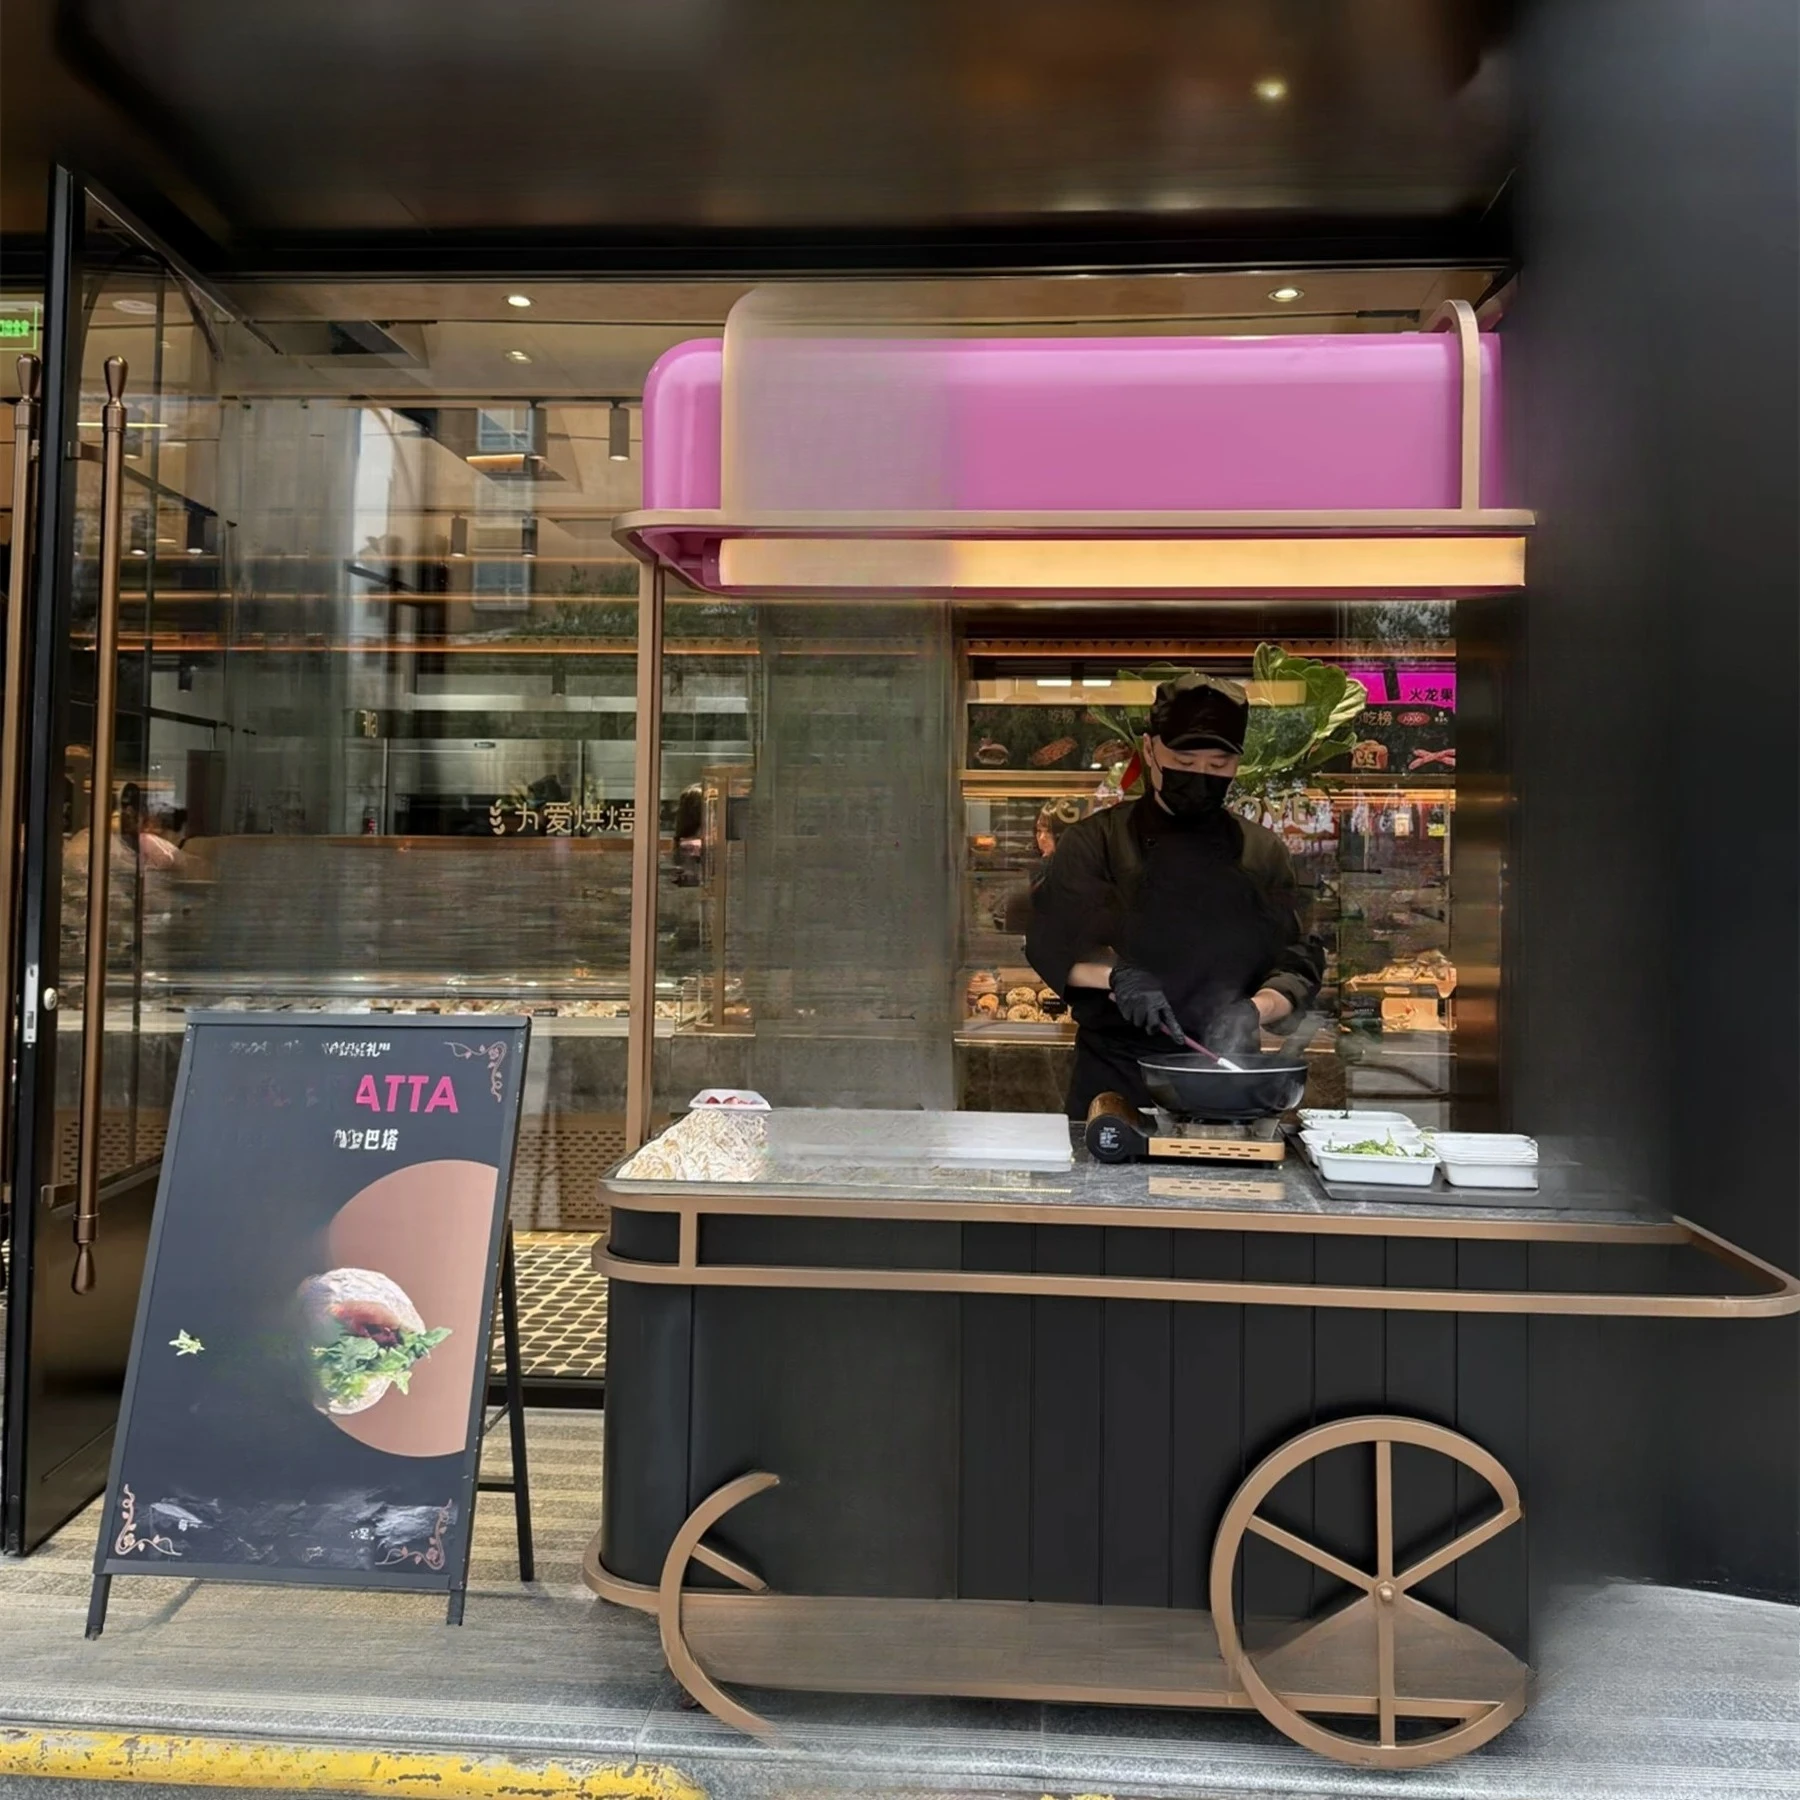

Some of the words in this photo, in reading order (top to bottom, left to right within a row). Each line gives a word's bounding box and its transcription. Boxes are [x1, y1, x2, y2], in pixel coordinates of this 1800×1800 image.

[1409, 687, 1453, 702] 火龙果
[1361, 710, 1393, 726] 吃榜
[514, 801, 635, 834] 为爱烘焙
[1232, 794, 1310, 825] OVE
[356, 1074, 459, 1113] ATTA
